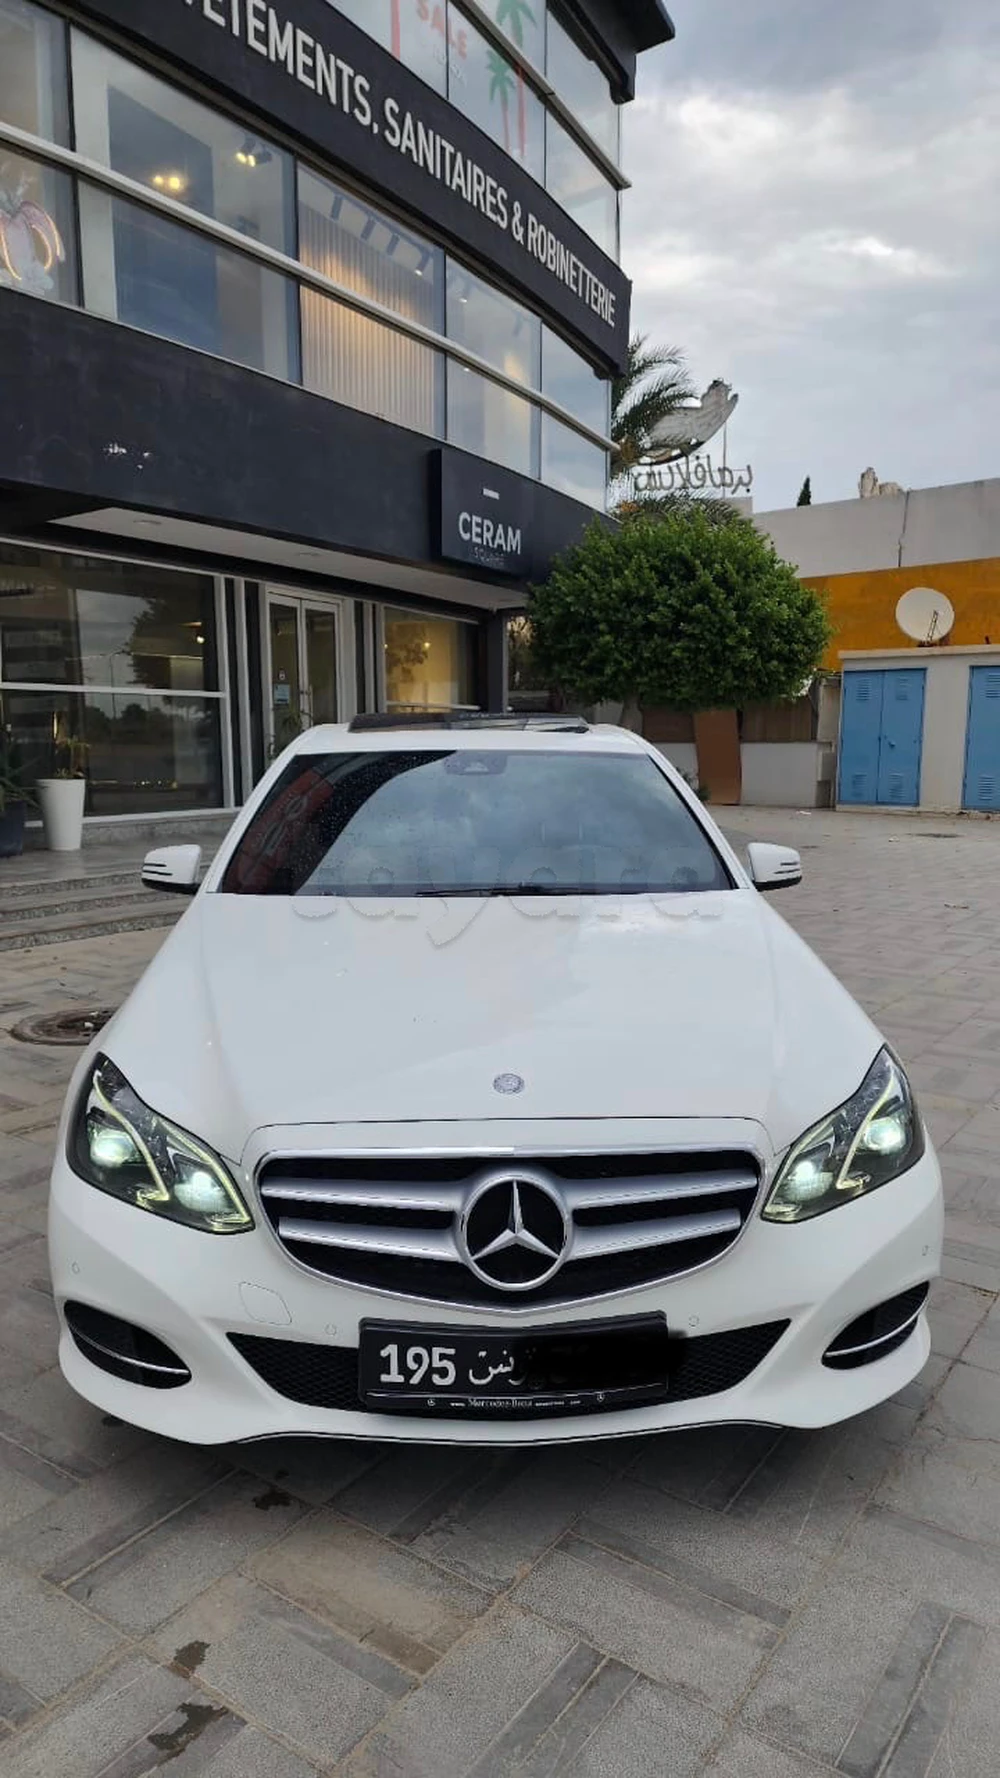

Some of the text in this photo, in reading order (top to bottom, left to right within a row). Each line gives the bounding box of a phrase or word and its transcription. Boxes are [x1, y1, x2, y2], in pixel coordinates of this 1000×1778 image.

[185, 0, 616, 328] TEMENTS, SANITAIRES & ROBINETTERIE
[458, 511, 521, 555] CERAM
[379, 1343, 457, 1386] 195
